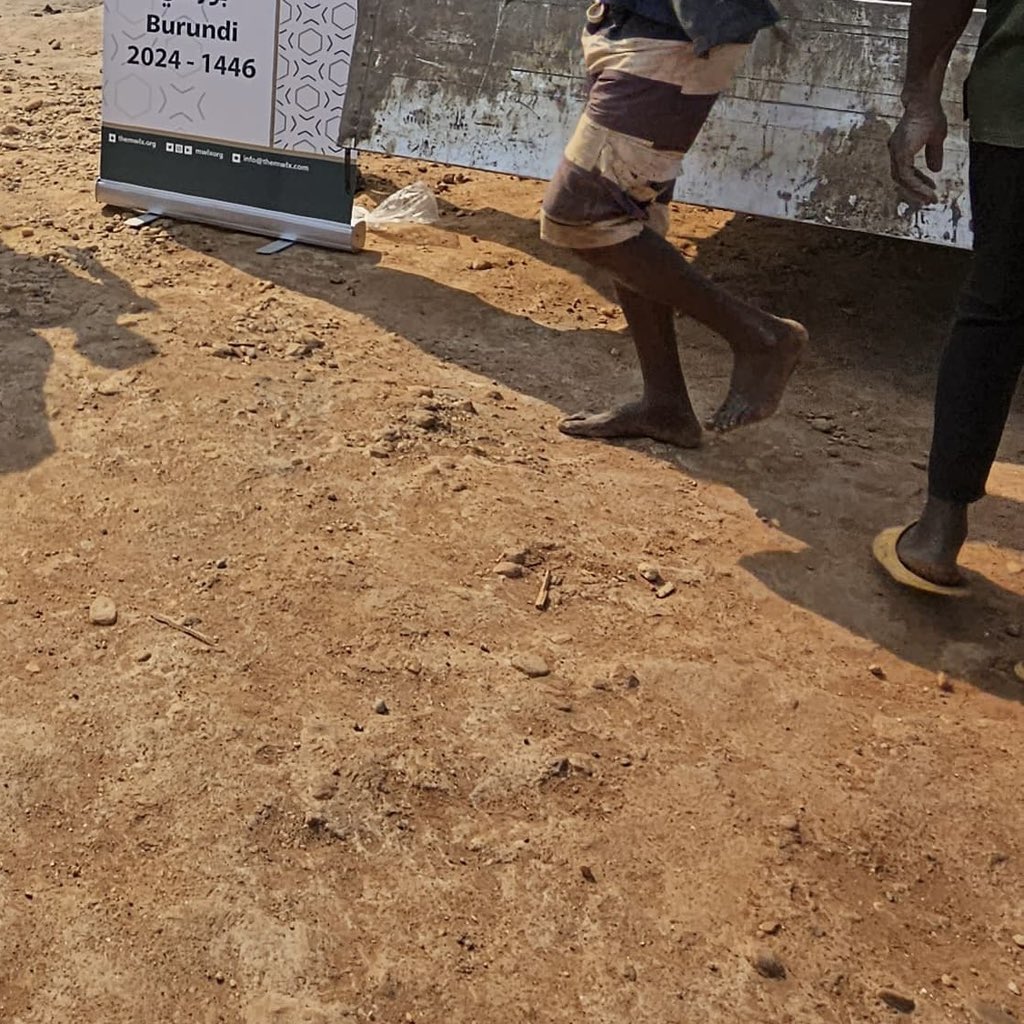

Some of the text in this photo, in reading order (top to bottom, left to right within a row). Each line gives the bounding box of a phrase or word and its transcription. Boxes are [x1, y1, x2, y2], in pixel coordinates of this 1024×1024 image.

[146, 14, 238, 42] Burundi
[127, 45, 181, 70] 2024
[201, 53, 256, 79] 1446
